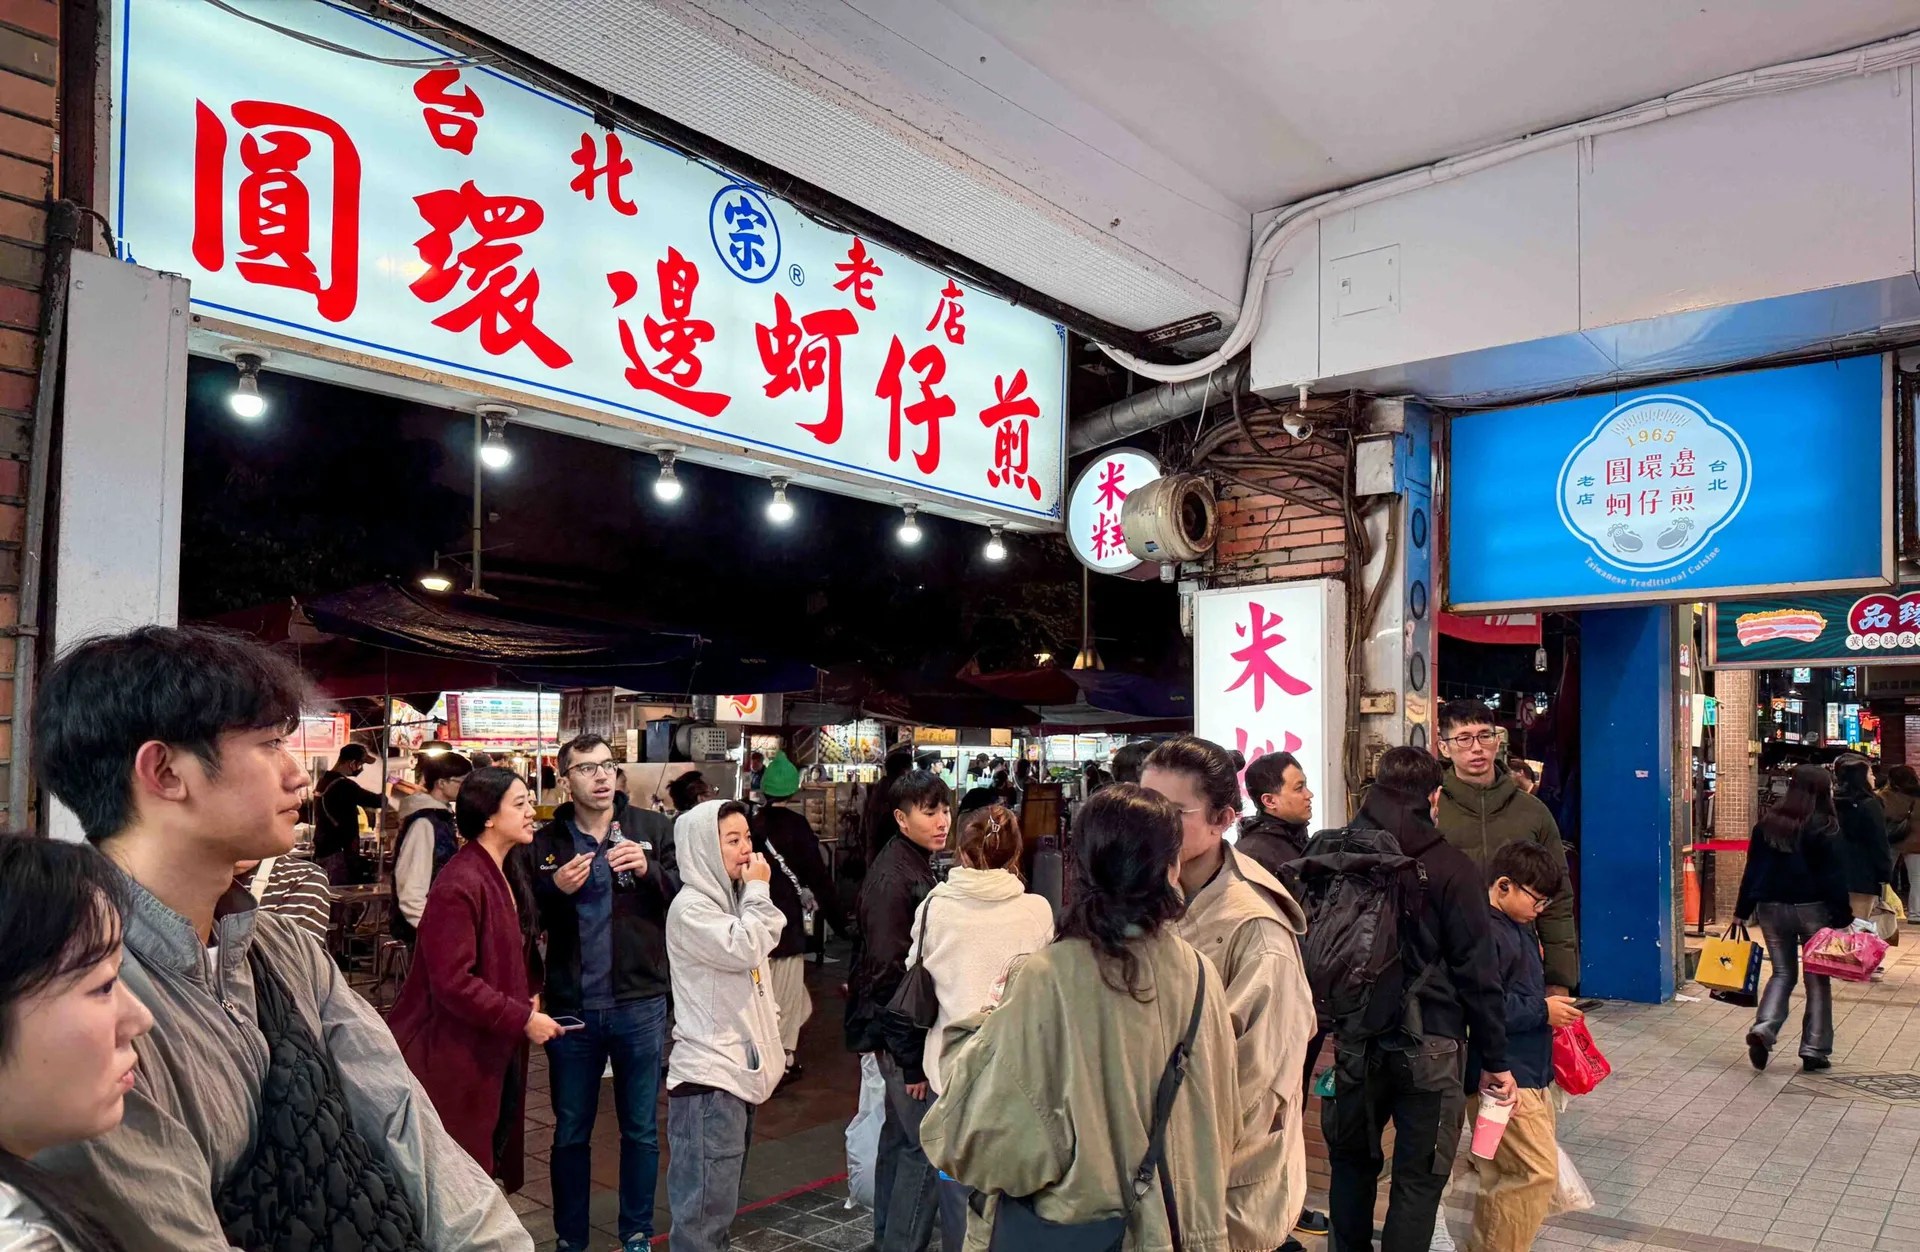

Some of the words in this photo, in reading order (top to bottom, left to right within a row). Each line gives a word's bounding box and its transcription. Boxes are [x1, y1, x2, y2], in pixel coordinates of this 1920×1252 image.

[413, 62, 638, 216] 台北
[721, 192, 770, 274] 宗
[833, 237, 966, 345] 老店
[192, 97, 1041, 500] 圓環邊蚵仔煎
[1625, 428, 1677, 448] 1965
[1606, 447, 1695, 485] 圓環邊
[1708, 459, 1728, 491] 台北
[1576, 475, 1595, 505] 老店
[1606, 486, 1695, 517] 蚵仔煎
[1584, 556, 1628, 585] Taiwanese
[1630, 570, 1687, 588] Traditional
[1688, 547, 1721, 575] Cuisine
[1849, 634, 1920, 648] 黃金脆皮
